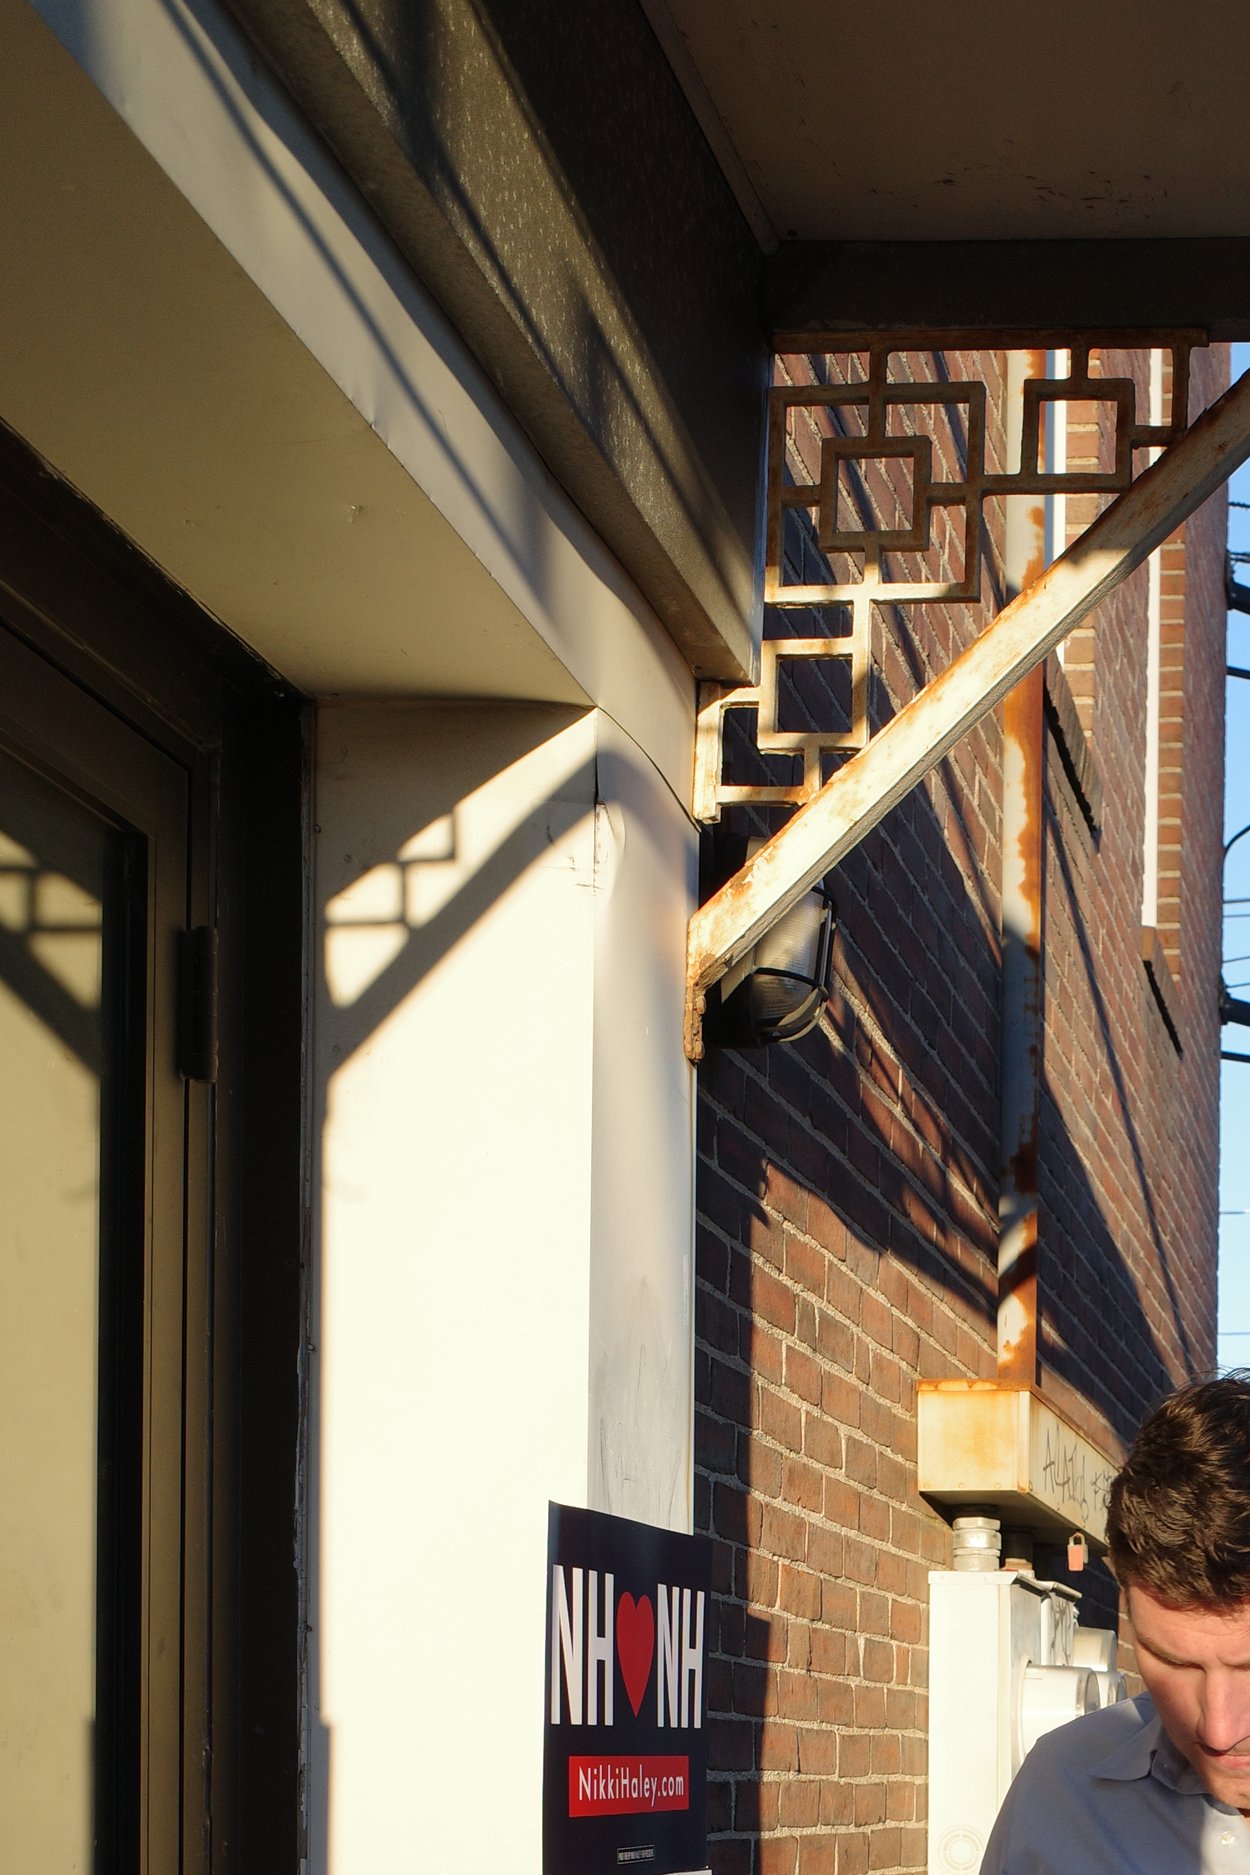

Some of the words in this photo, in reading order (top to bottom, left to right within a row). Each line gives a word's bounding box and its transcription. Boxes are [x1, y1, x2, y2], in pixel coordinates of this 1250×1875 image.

[551, 1564, 615, 1726] NH
[657, 1583, 705, 1729] NH
[579, 1764, 684, 1807] NikkiHaley.com
